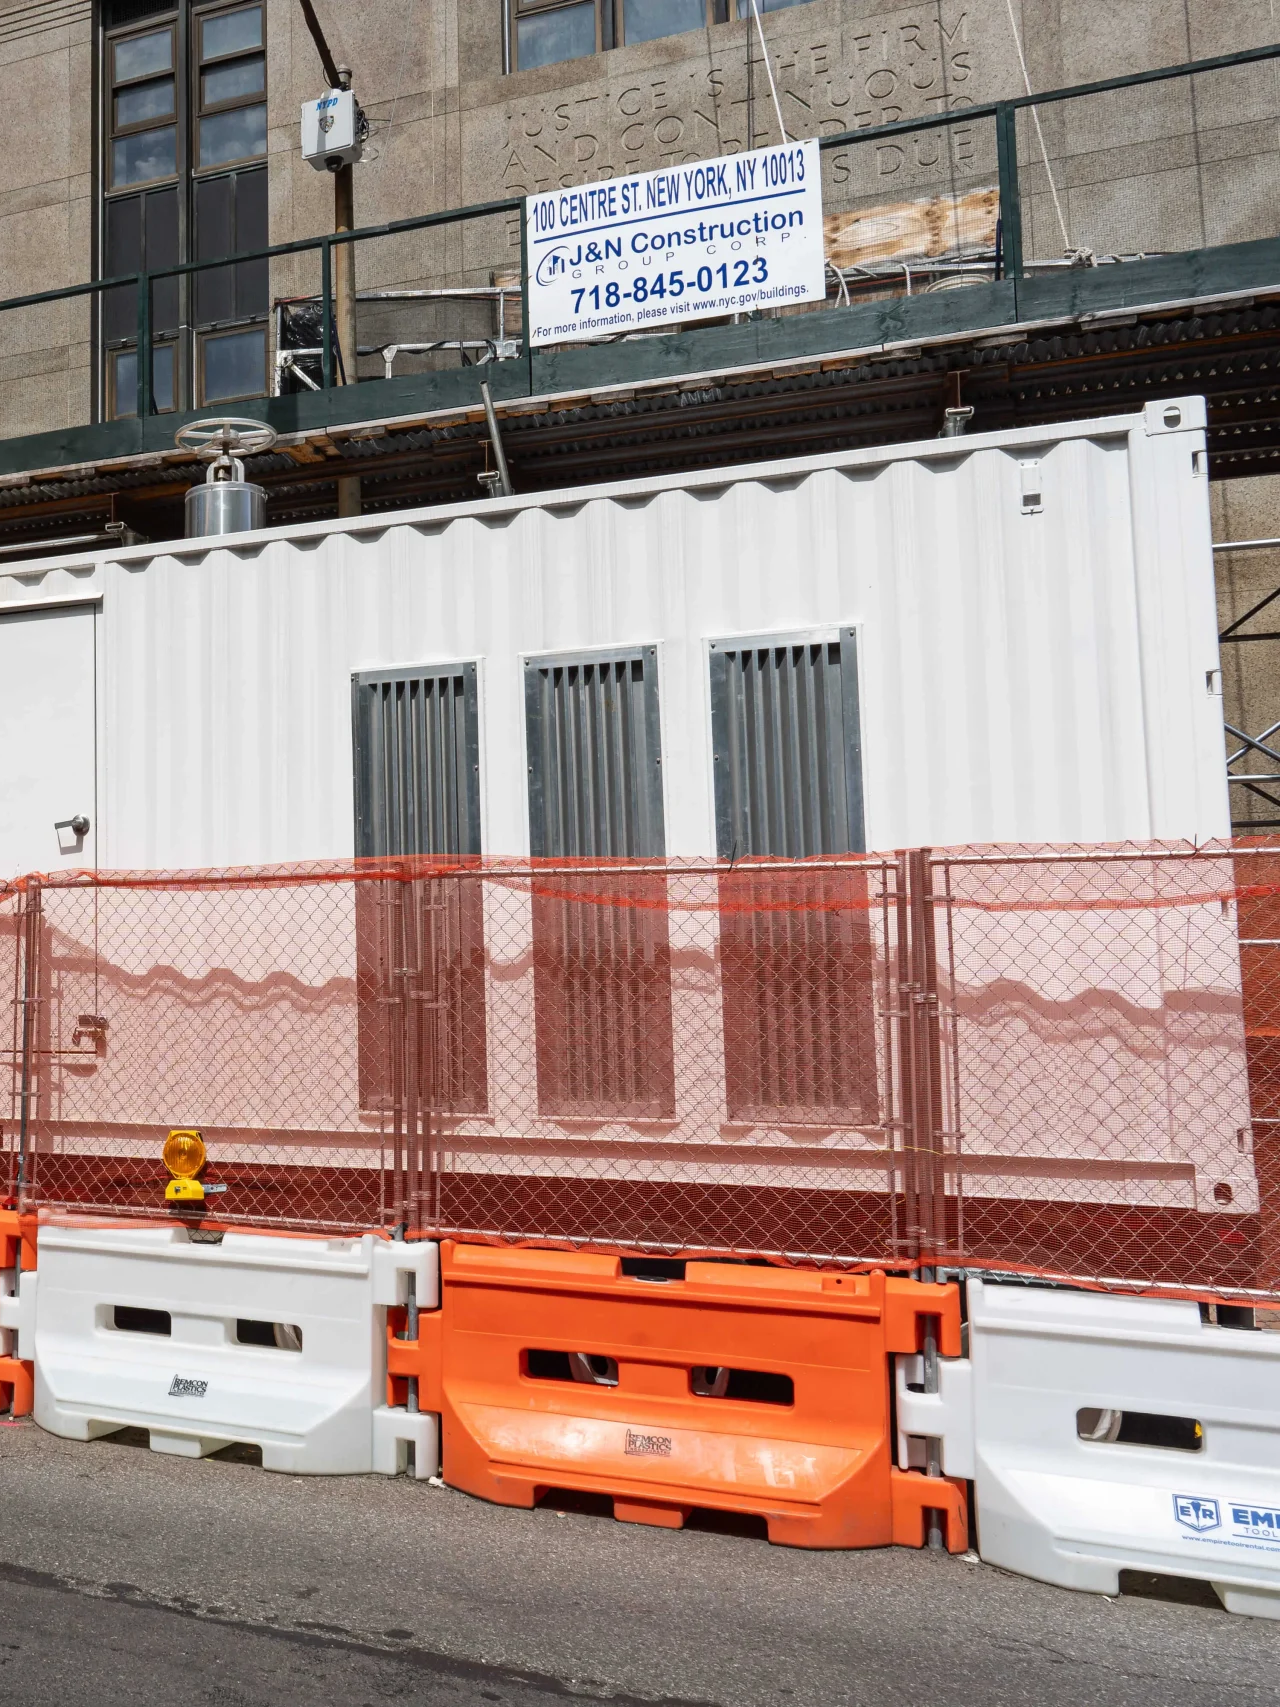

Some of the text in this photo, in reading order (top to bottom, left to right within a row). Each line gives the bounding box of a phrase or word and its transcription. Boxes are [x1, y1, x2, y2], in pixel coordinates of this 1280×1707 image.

[316, 97, 338, 111] NYPD
[501, 12, 968, 149] JUSTICE IS THE FIRM
[501, 51, 972, 179] AND CONTINUOUS
[875, 128, 974, 176] DUE
[533, 199, 555, 232] 100
[560, 185, 617, 227] CENTRE
[621, 181, 642, 214] ST.
[647, 172, 680, 210] NEW
[684, 163, 732, 201] YORK,
[736, 157, 757, 193] NY
[762, 148, 805, 188] 10013
[569, 209, 804, 266] J&N Construction
[571, 232, 807, 279] GROUP CORP.
[570, 256, 769, 314] 718-845-0123
[537, 284, 809, 338] For more information, please visit www.nyc.gov/buildings.
[628, 1433, 672, 1445] REMCON
[628, 1440, 672, 1451] PLASTICS
[1232, 1508, 1280, 1530] EM
[1243, 1526, 1278, 1538] TOOL
